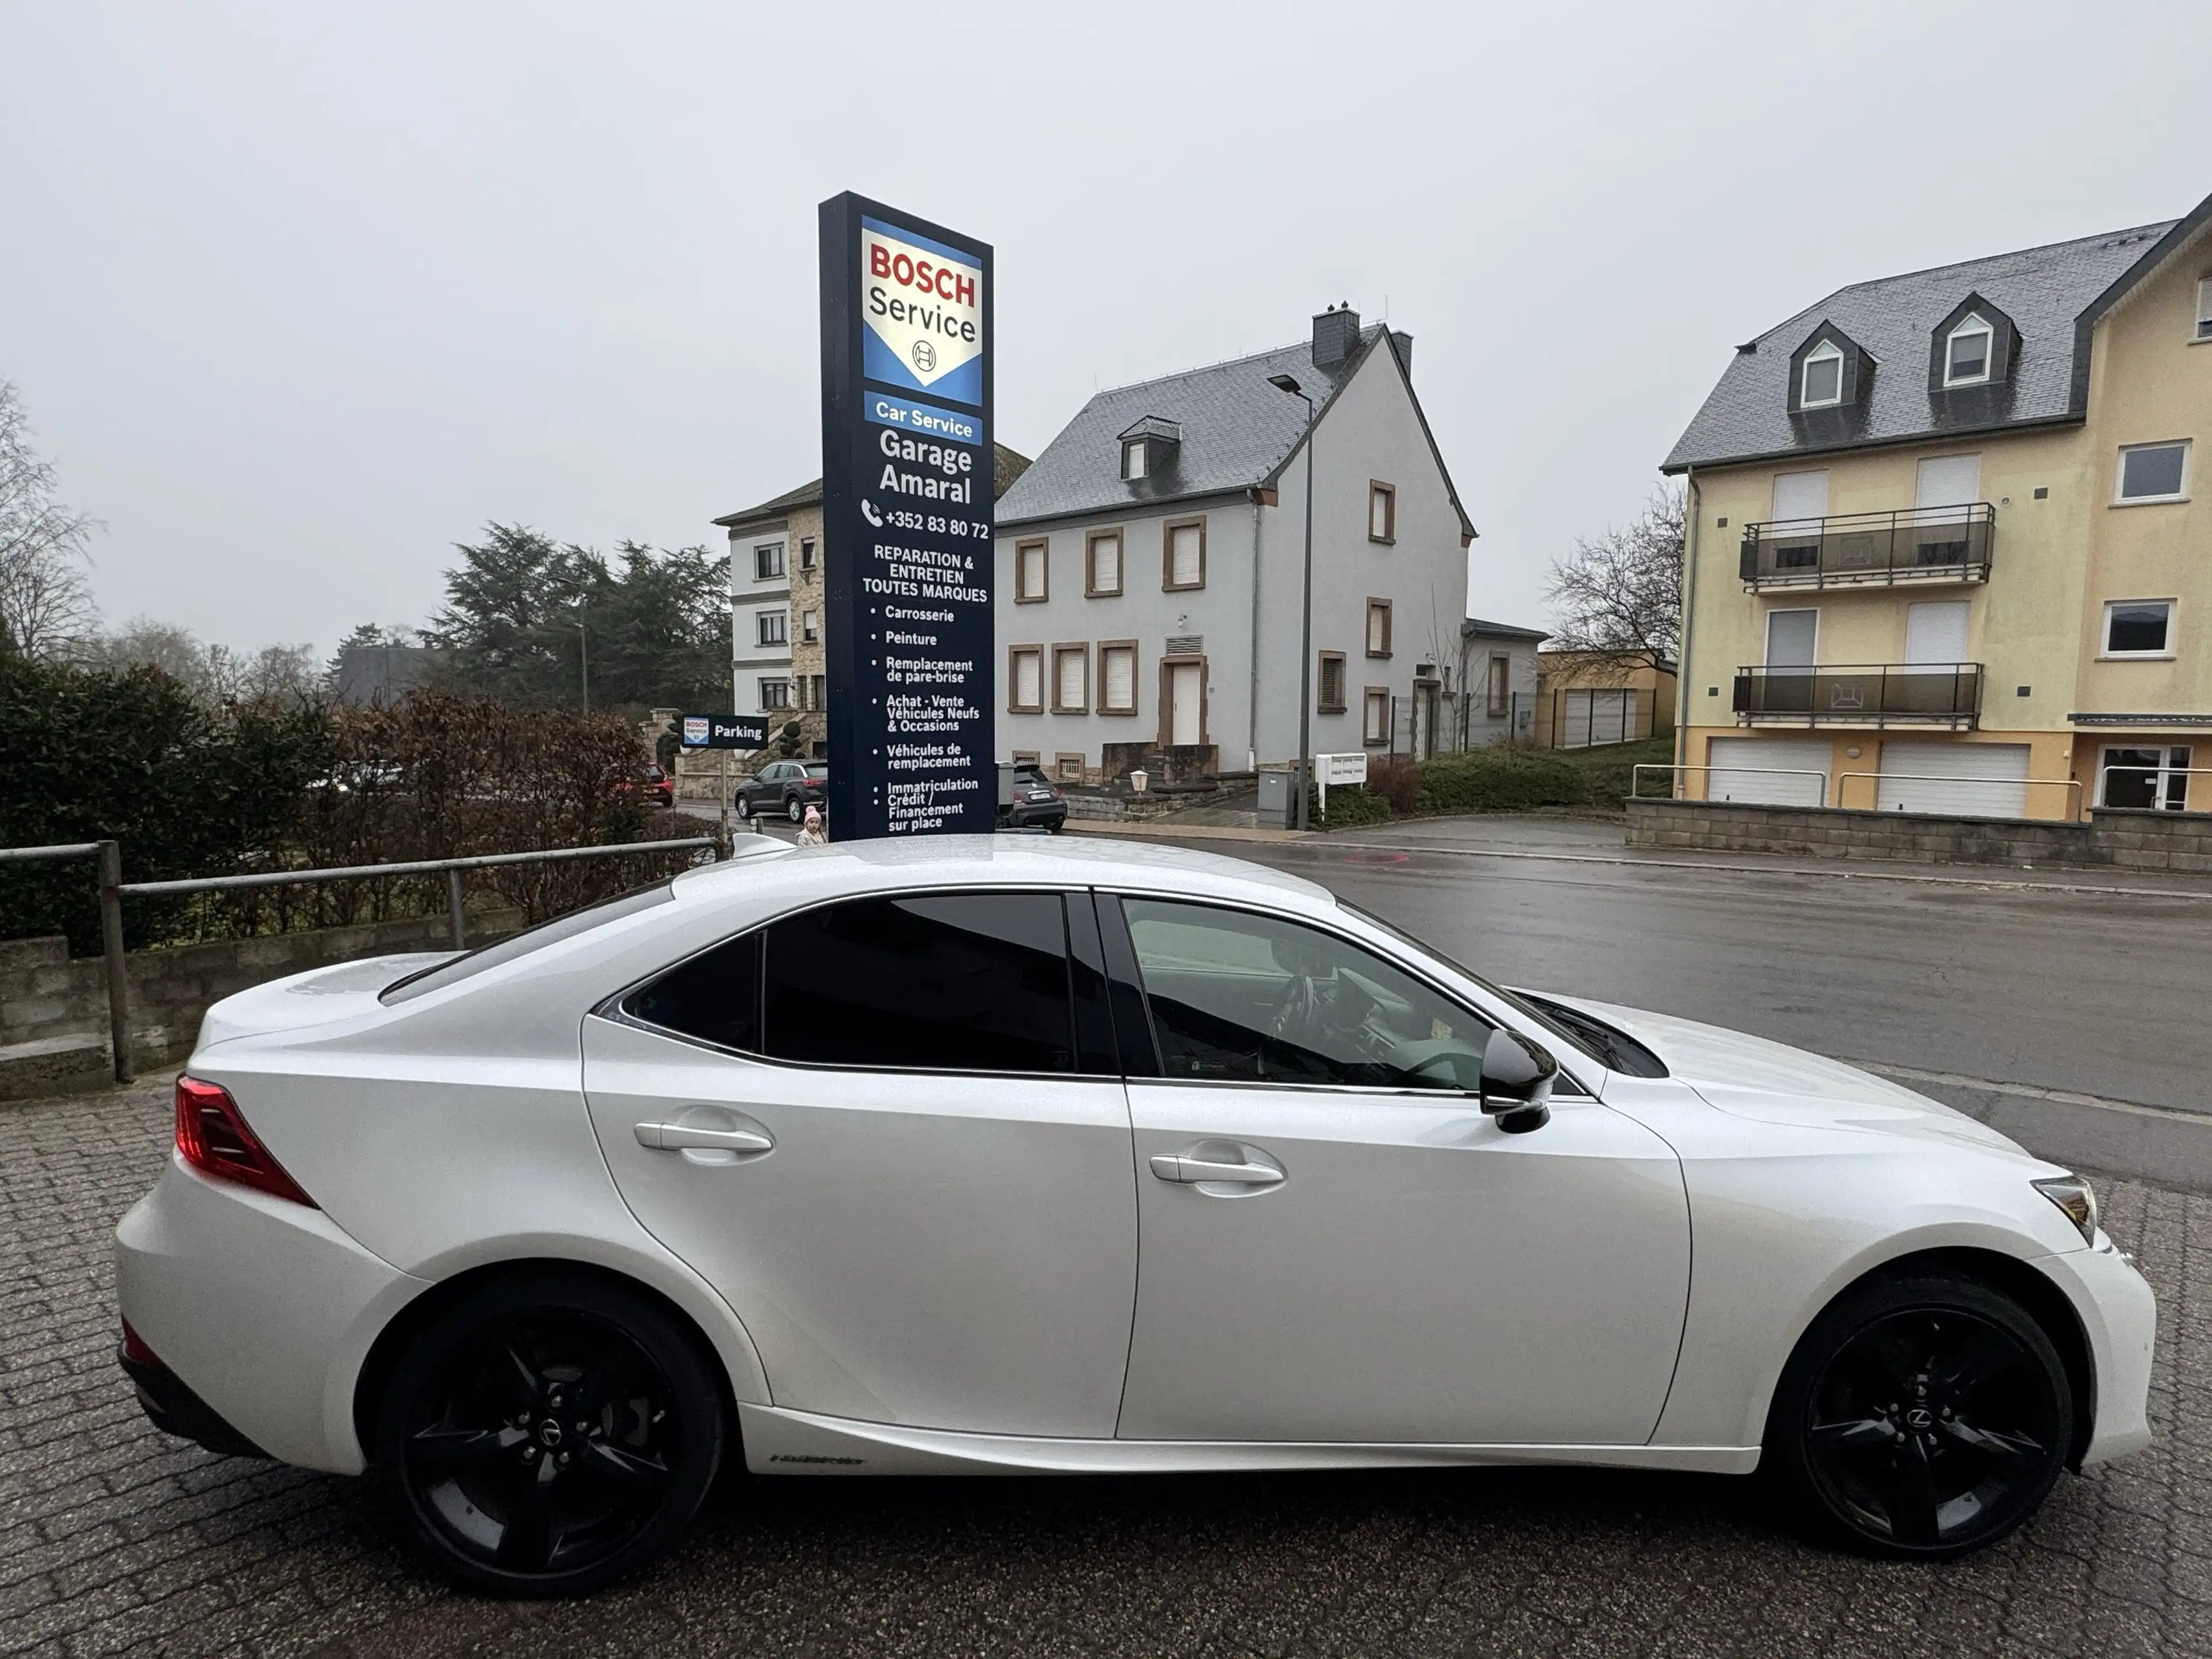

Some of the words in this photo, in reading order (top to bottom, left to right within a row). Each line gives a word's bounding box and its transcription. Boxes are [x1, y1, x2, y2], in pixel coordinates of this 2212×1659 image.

[871, 243, 975, 308] BOSCH
[869, 286, 975, 343] Service
[876, 402, 908, 422] Car
[911, 410, 973, 437] Service
[880, 429, 972, 475] Garage
[879, 464, 970, 504] Amaral
[886, 510, 923, 530] +352
[927, 516, 946, 533] 83
[950, 519, 968, 536] 80
[971, 522, 989, 540] 72
[874, 544, 961, 568] REPARATION
[964, 556, 974, 569] &
[890, 563, 964, 585] ENTRETIEN
[863, 577, 918, 597] TOUTES
[922, 583, 988, 603] MARQUES
[885, 605, 955, 622] Carrosserie
[886, 631, 937, 646] Peinture
[886, 656, 973, 672] Remplacement
[887, 669, 902, 682] de
[905, 670, 965, 685] pare-brise
[886, 694, 922, 707] Achat
[931, 695, 965, 707] Vente
[887, 706, 944, 719] Véhicules
[947, 706, 980, 719] Neufs
[715, 724, 762, 741] Parking
[887, 719, 897, 732] &
[900, 719, 960, 732] Occasions
[887, 743, 944, 757] Véhicules
[947, 743, 961, 755] de
[888, 755, 971, 772] remplacement
[887, 778, 978, 795] Immatriculation
[887, 793, 926, 807] Crédit
[928, 791, 935, 806] /
[888, 802, 964, 819] Financement
[888, 820, 909, 832] sur
[911, 816, 943, 832] place
